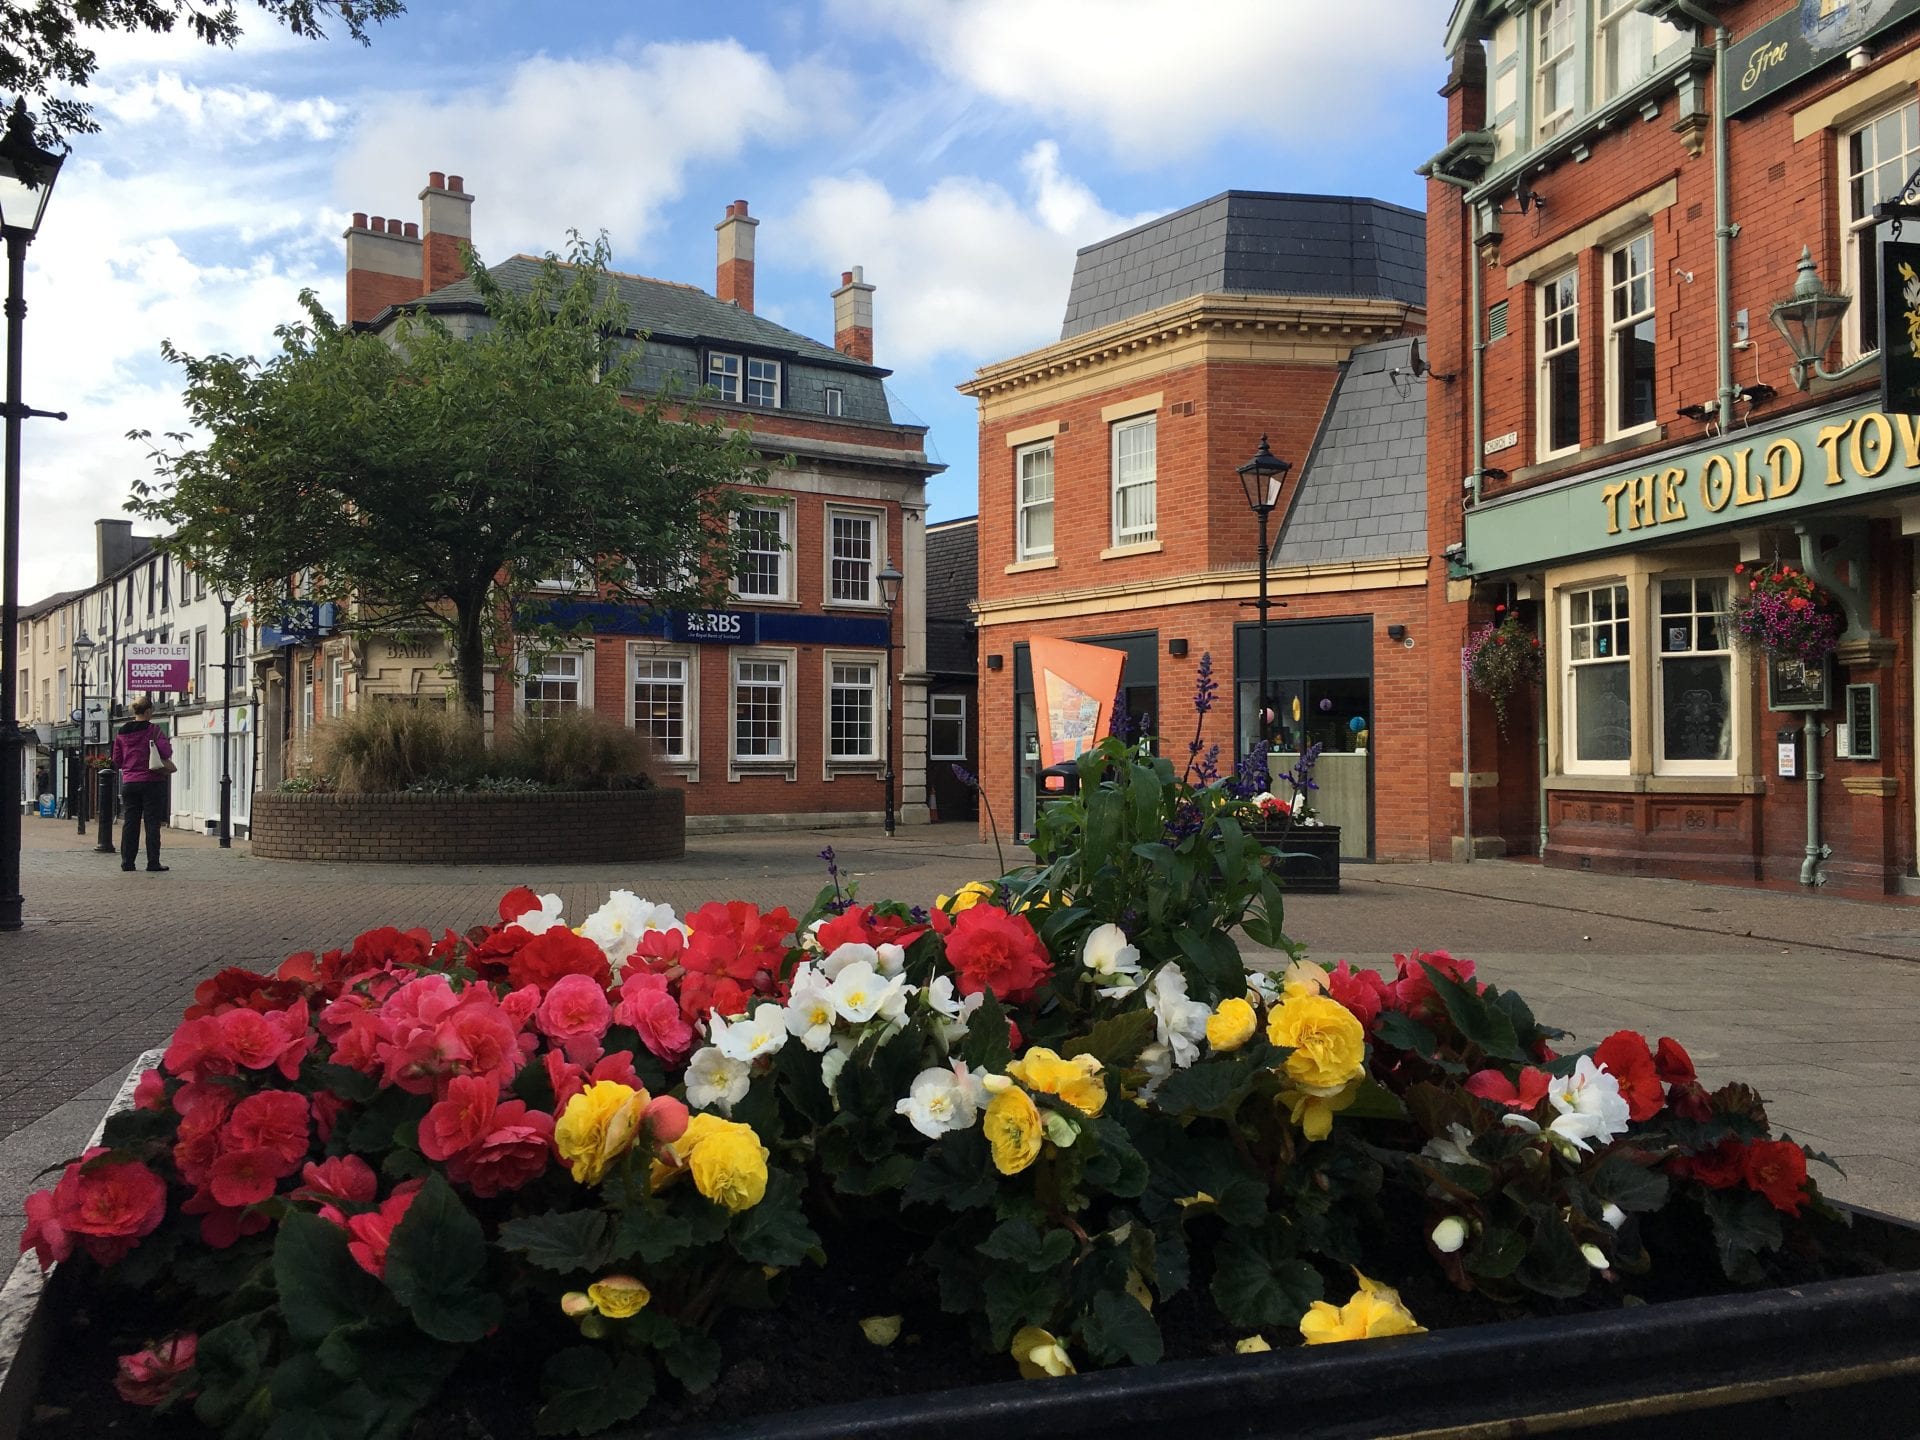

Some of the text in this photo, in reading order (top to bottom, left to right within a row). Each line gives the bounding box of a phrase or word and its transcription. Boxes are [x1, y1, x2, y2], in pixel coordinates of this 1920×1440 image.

[1741, 40, 1789, 92] Free
[1485, 437, 1506, 452] CHURCH
[1602, 467, 1688, 535] THE
[1701, 437, 1804, 513] OLD
[706, 613, 741, 633] RBS
[132, 646, 187, 656] SHOP TO LET
[386, 642, 432, 659] BANK
[131, 663, 172, 671] mason
[131, 670, 164, 678] owen
